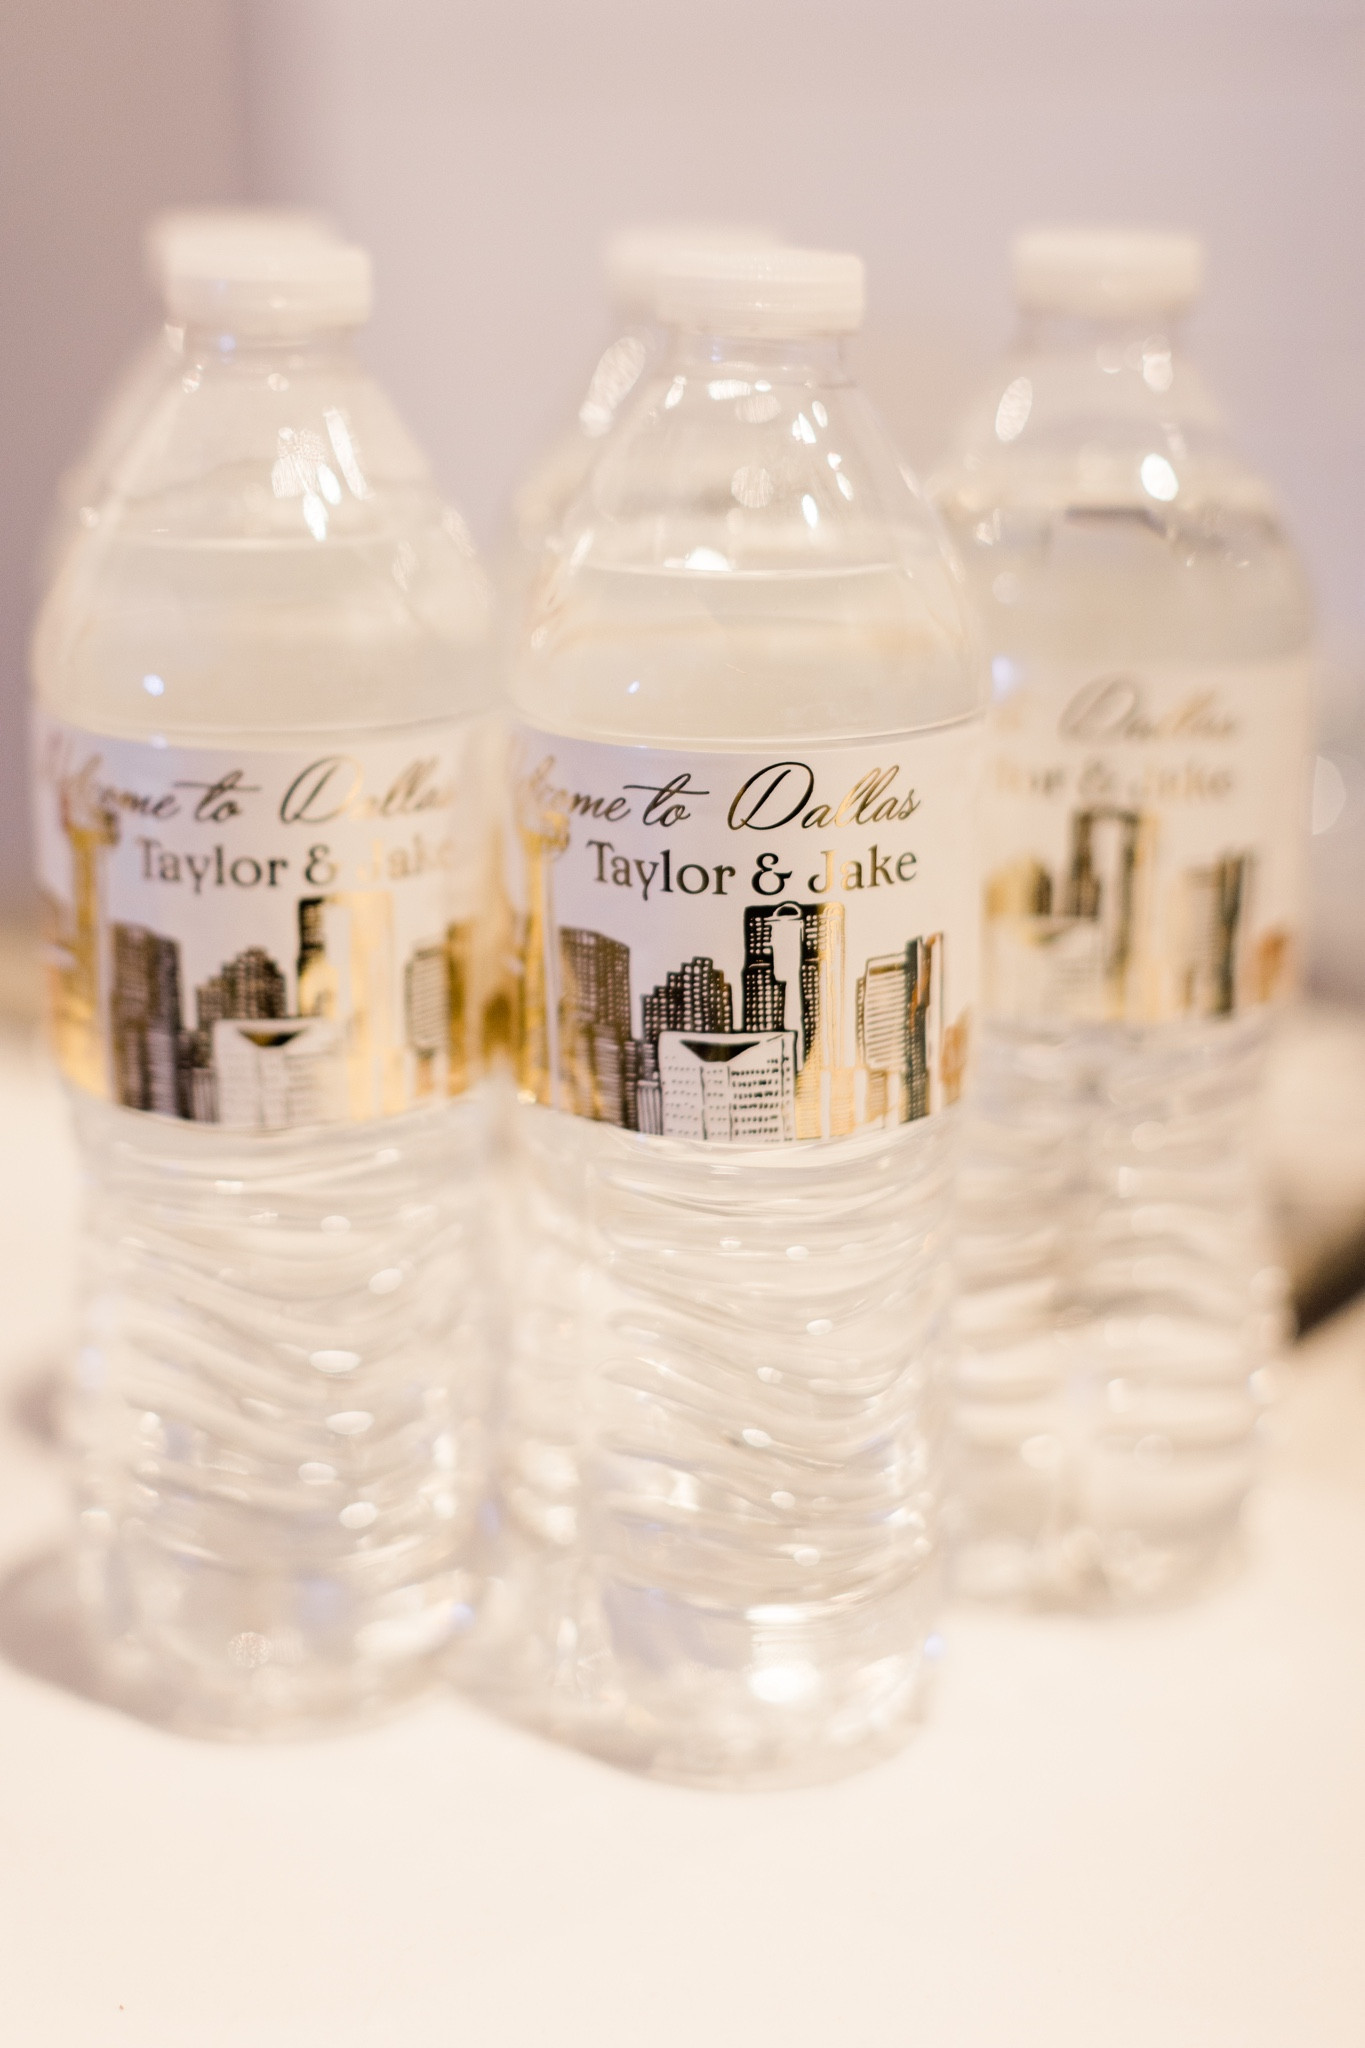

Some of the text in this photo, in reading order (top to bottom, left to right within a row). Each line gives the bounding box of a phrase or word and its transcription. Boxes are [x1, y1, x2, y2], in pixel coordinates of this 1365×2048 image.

[174, 770, 260, 823] to
[623, 773, 709, 827] to
[727, 761, 921, 831] Dallas
[137, 835, 290, 893] Taylor
[304, 844, 338, 885] &
[586, 839, 918, 901] Taylor & Jake
